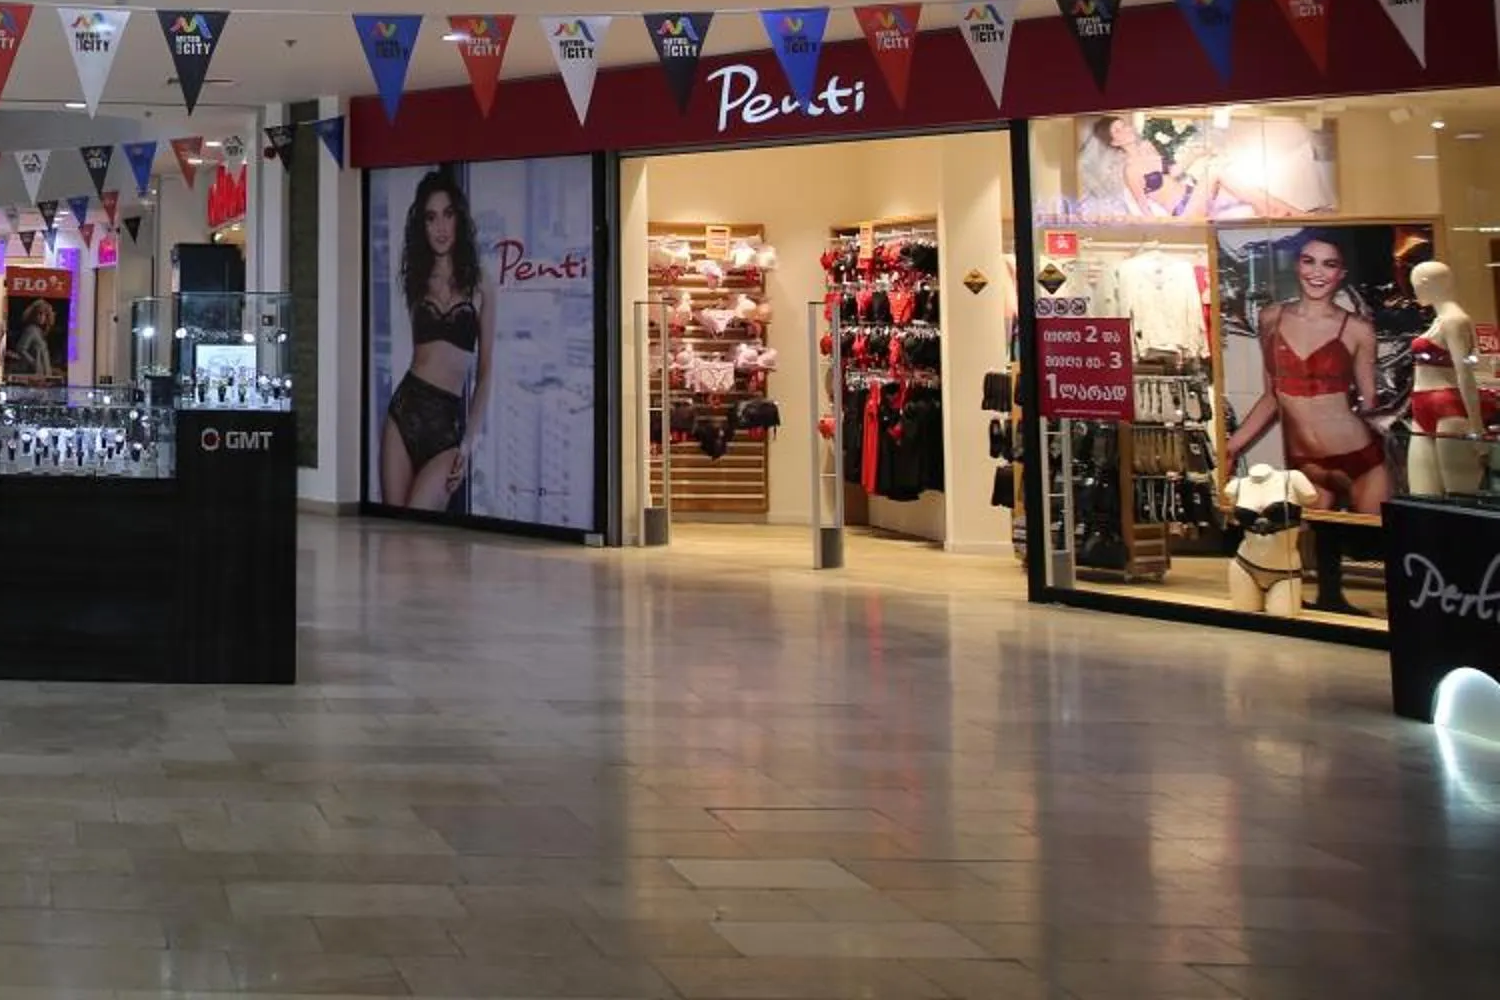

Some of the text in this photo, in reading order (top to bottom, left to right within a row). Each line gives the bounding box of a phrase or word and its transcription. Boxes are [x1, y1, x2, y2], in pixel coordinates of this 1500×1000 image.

[980, 31, 1004, 42] CITY
[83, 40, 110, 52] CITY
[183, 43, 211, 55] CITY
[884, 38, 909, 49] CITY
[567, 48, 595, 59] CITY
[672, 46, 698, 57] CITY
[494, 239, 588, 285] Penti
[1085, 326, 1098, 342] 2
[1110, 352, 1122, 369] 3
[225, 431, 273, 450] GMT
